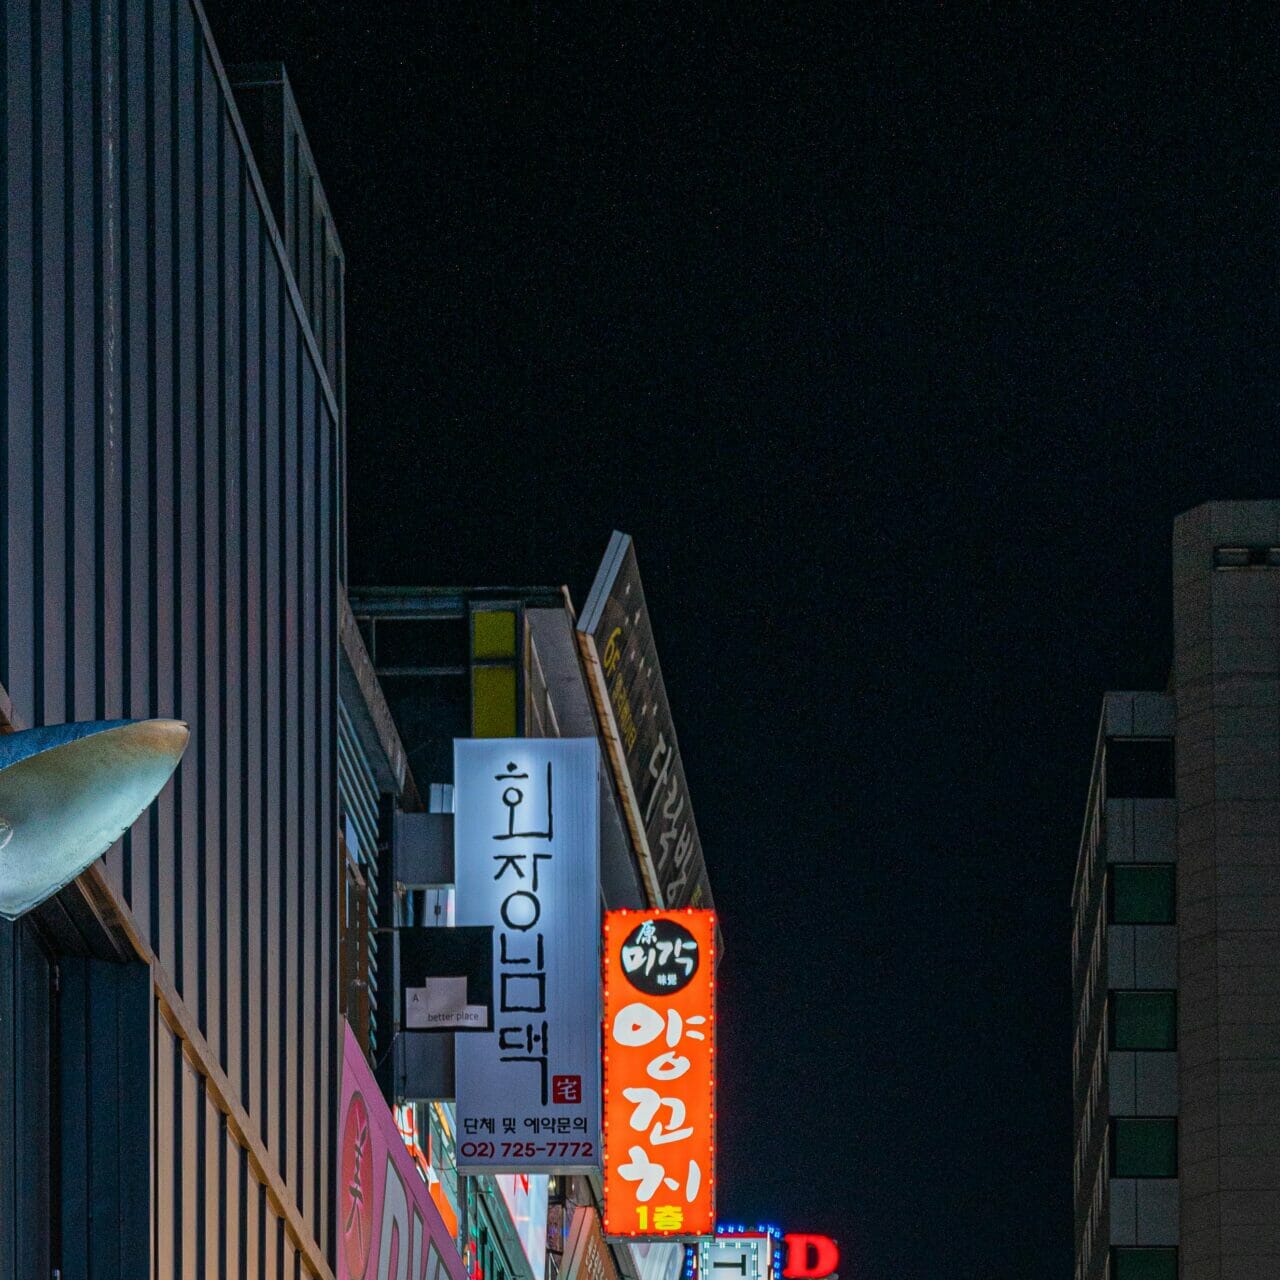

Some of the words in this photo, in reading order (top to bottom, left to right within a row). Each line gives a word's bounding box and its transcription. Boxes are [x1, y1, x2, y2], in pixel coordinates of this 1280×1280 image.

[493, 760, 555, 1107] 회장님댁
[412, 994, 419, 1003] A
[427, 1012, 453, 1023] better
[456, 1012, 479, 1024] place
[557, 1079, 577, 1101] 宅
[464, 1118, 495, 1134] 단체
[503, 1118, 517, 1133] 및
[524, 1117, 588, 1134] 예약문의
[501, 1142, 593, 1157] 725-7772
[635, 1204, 685, 1232] 1층
